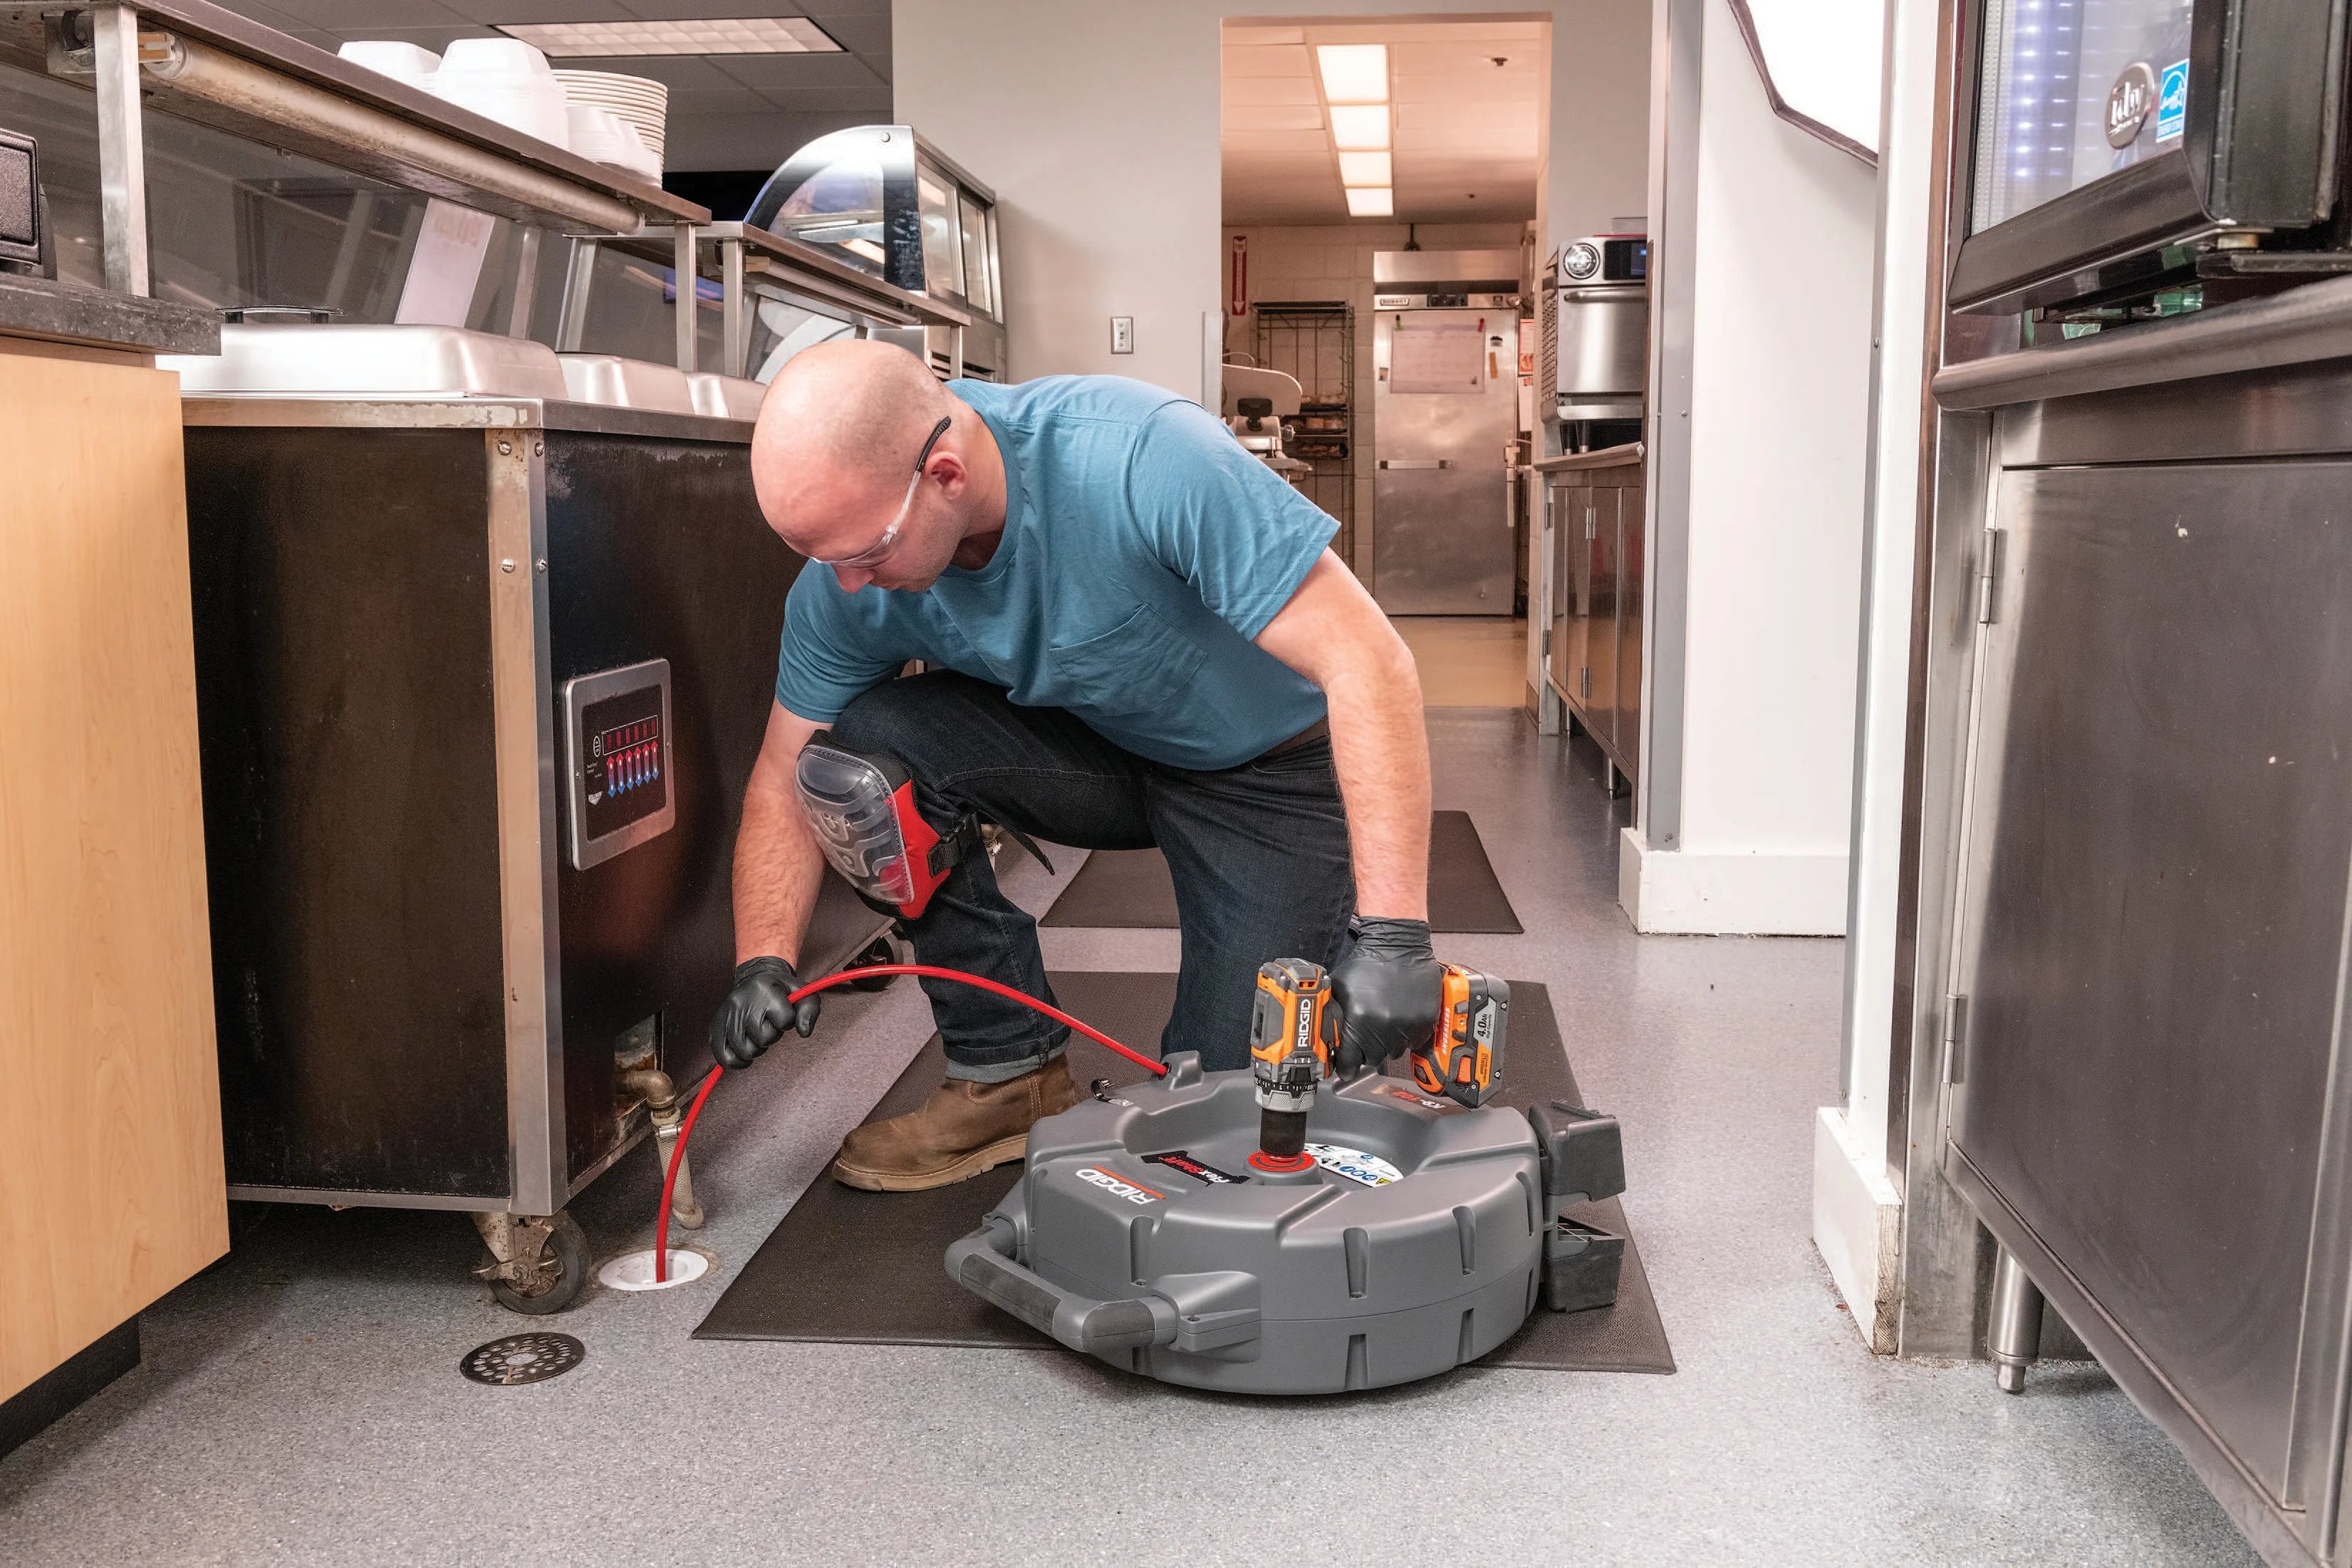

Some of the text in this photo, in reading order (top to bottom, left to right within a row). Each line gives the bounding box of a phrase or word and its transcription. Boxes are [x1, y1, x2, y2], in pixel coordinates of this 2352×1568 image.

[1297, 998, 1311, 1047] RIDGID
[1477, 1013, 1488, 1038] 4.0Ah
[1076, 1169, 1156, 1205] RIDGID
